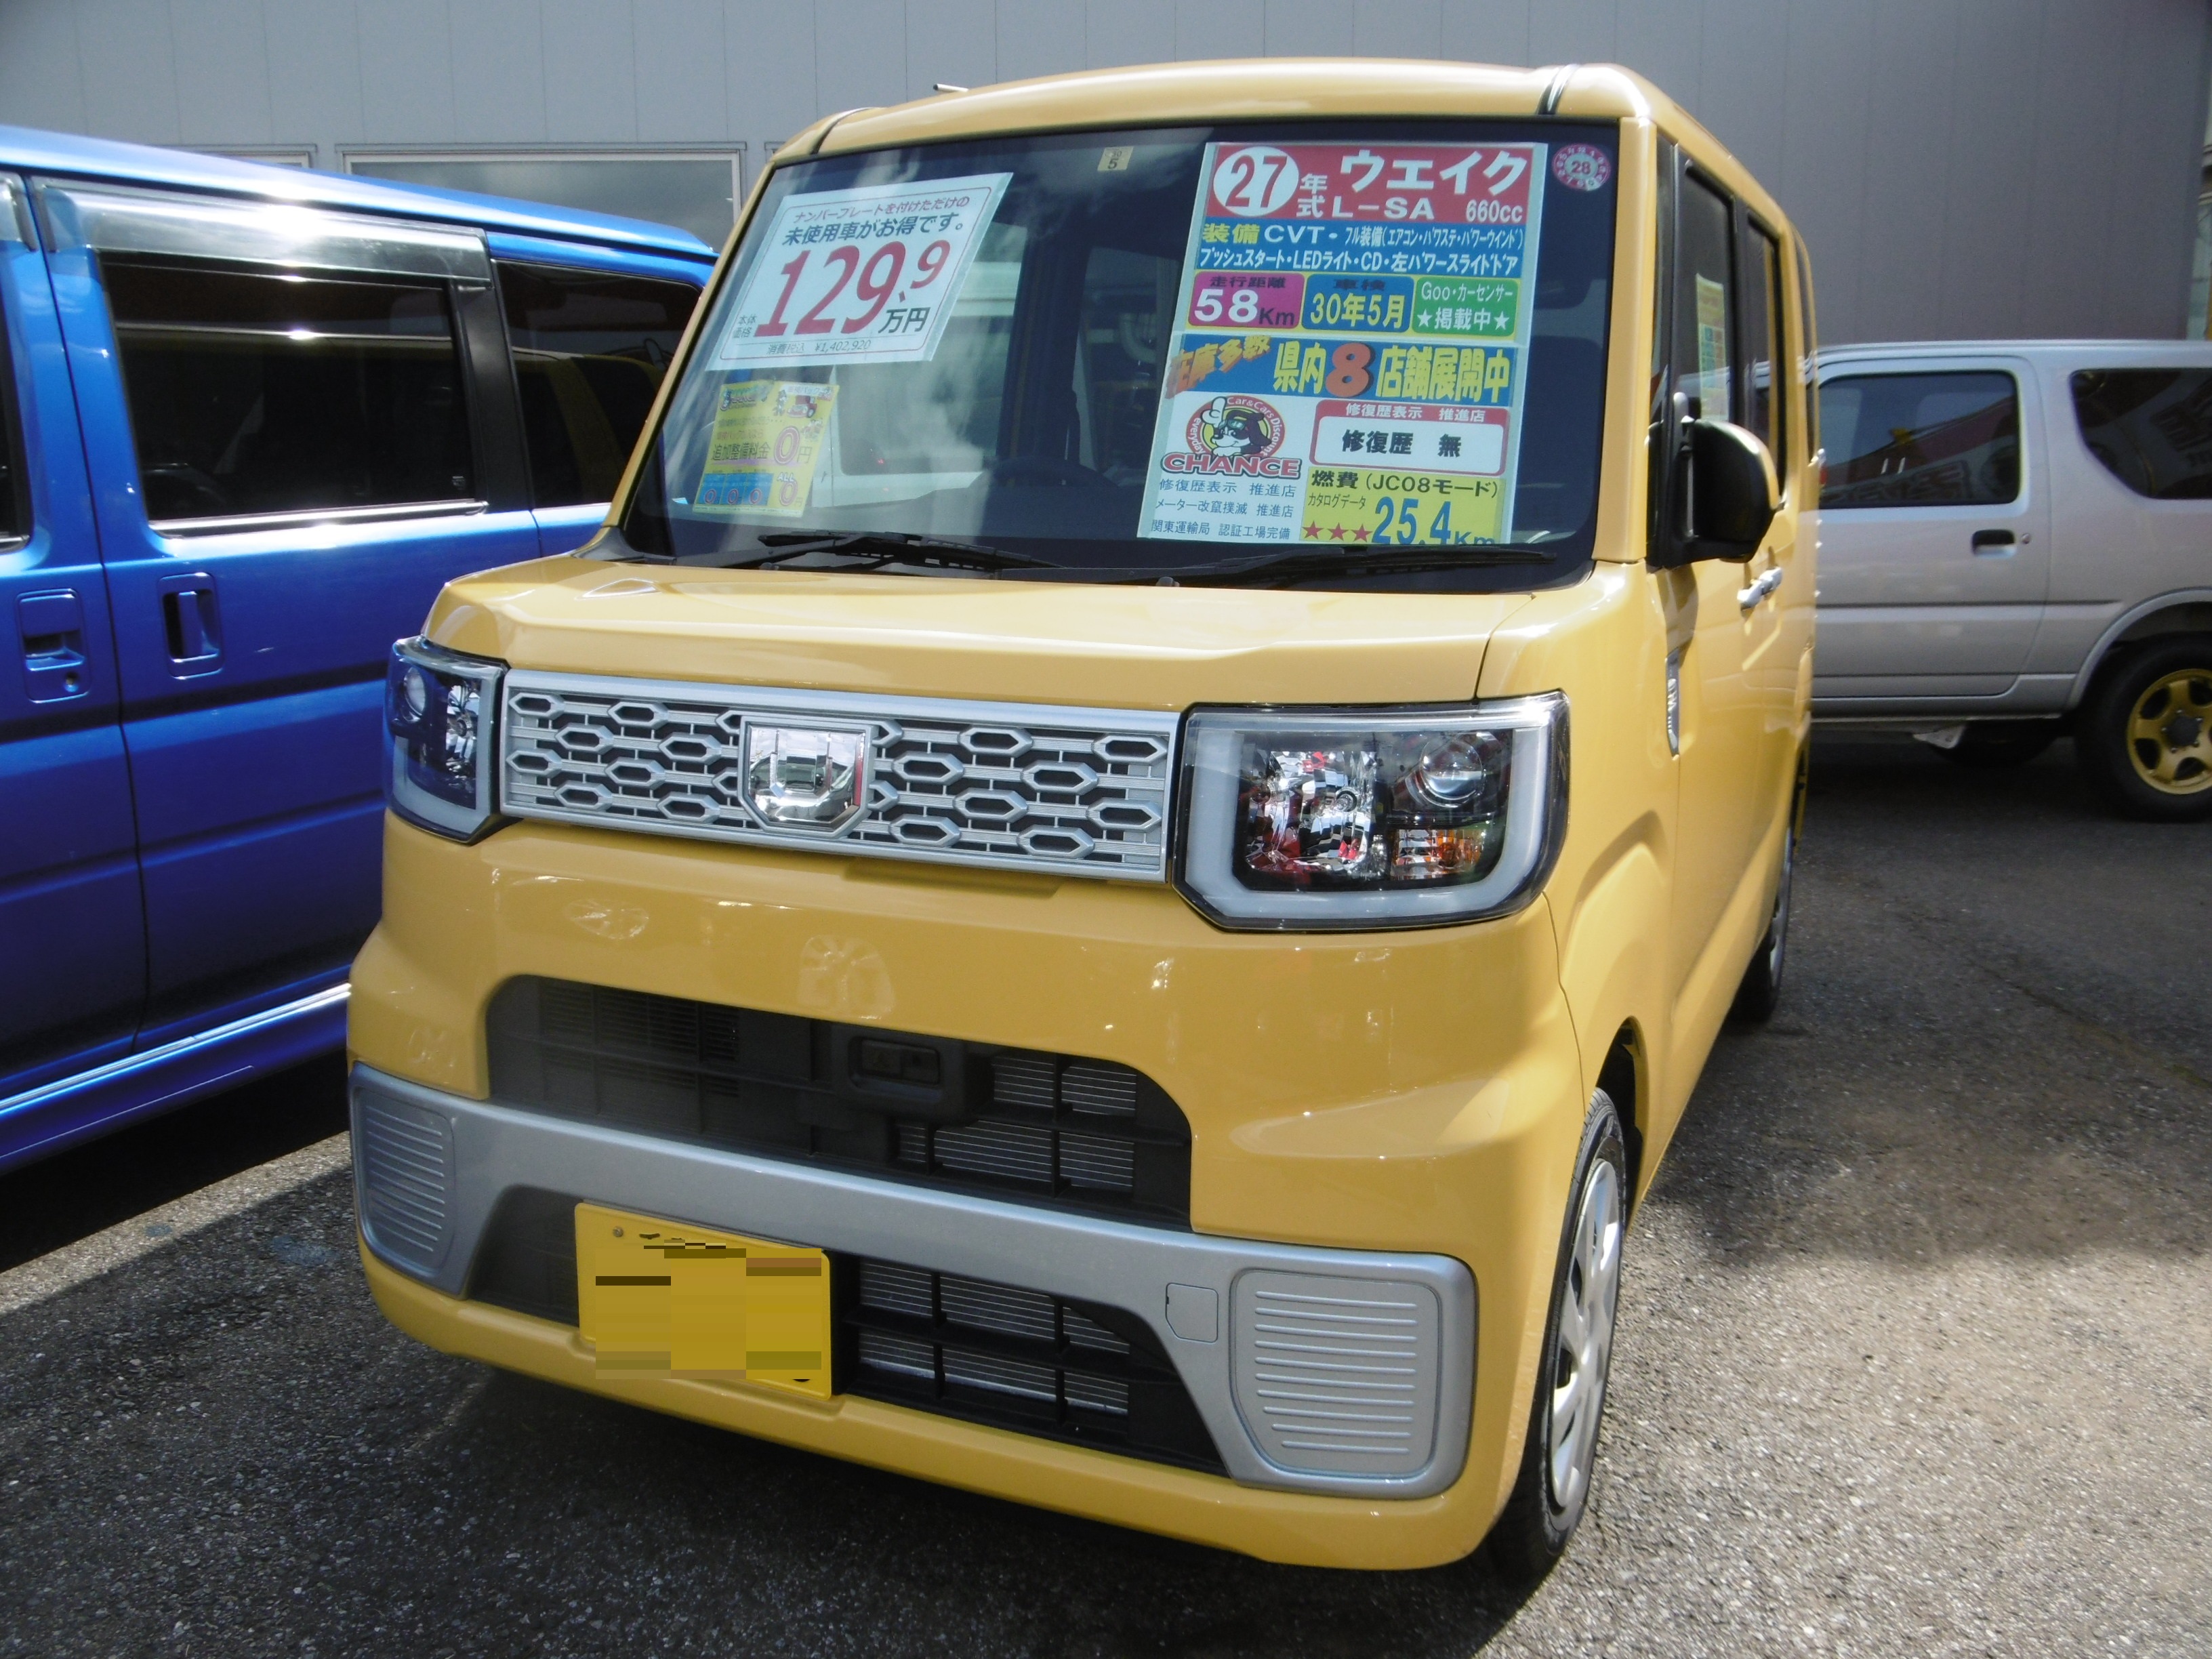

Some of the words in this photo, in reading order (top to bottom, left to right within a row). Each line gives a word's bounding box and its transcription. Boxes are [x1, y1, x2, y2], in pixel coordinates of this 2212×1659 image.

[1107, 158, 1120, 169] 5
[1340, 149, 1528, 196] ウエイク
[1571, 161, 1591, 175] 28
[1225, 155, 1288, 208] 27
[794, 196, 970, 224] ナンバープレートを付けただけの
[1466, 199, 1523, 222] 660cc
[782, 211, 963, 246] 未使用車がお得です。
[1202, 223, 1260, 245] 装備
[1209, 276, 1286, 289] 走行距離
[1194, 289, 1258, 323] 58
[1258, 308, 1295, 325] Km
[1310, 292, 1406, 329] 30年5月
[878, 307, 930, 334] 万円
[766, 343, 804, 355] 消費税込
[815, 340, 872, 352] ¥1,402,920
[1346, 403, 1422, 419] 修復歴表示
[1439, 408, 1486, 422] 推進店
[1187, 417, 1206, 455] everyday
[1227, 396, 1274, 419] Car&Cars
[1261, 417, 1283, 457] Discount
[1342, 429, 1414, 455] 修復歴
[1438, 434, 1462, 457] 無
[776, 471, 796, 483] ALL
[1161, 452, 1302, 479] CHANCE
[1160, 478, 1237, 493] 修復歴表示
[1250, 483, 1297, 497] 推進店
[1311, 470, 1359, 489] 燃費
[1256, 503, 1294, 518] 推進店
[1308, 493, 1366, 510] カタログデータ
[1151, 519, 1210, 535] 関東運輸局
[1218, 523, 1291, 540] 認証工場完備
[1371, 496, 1452, 545] 25.4
